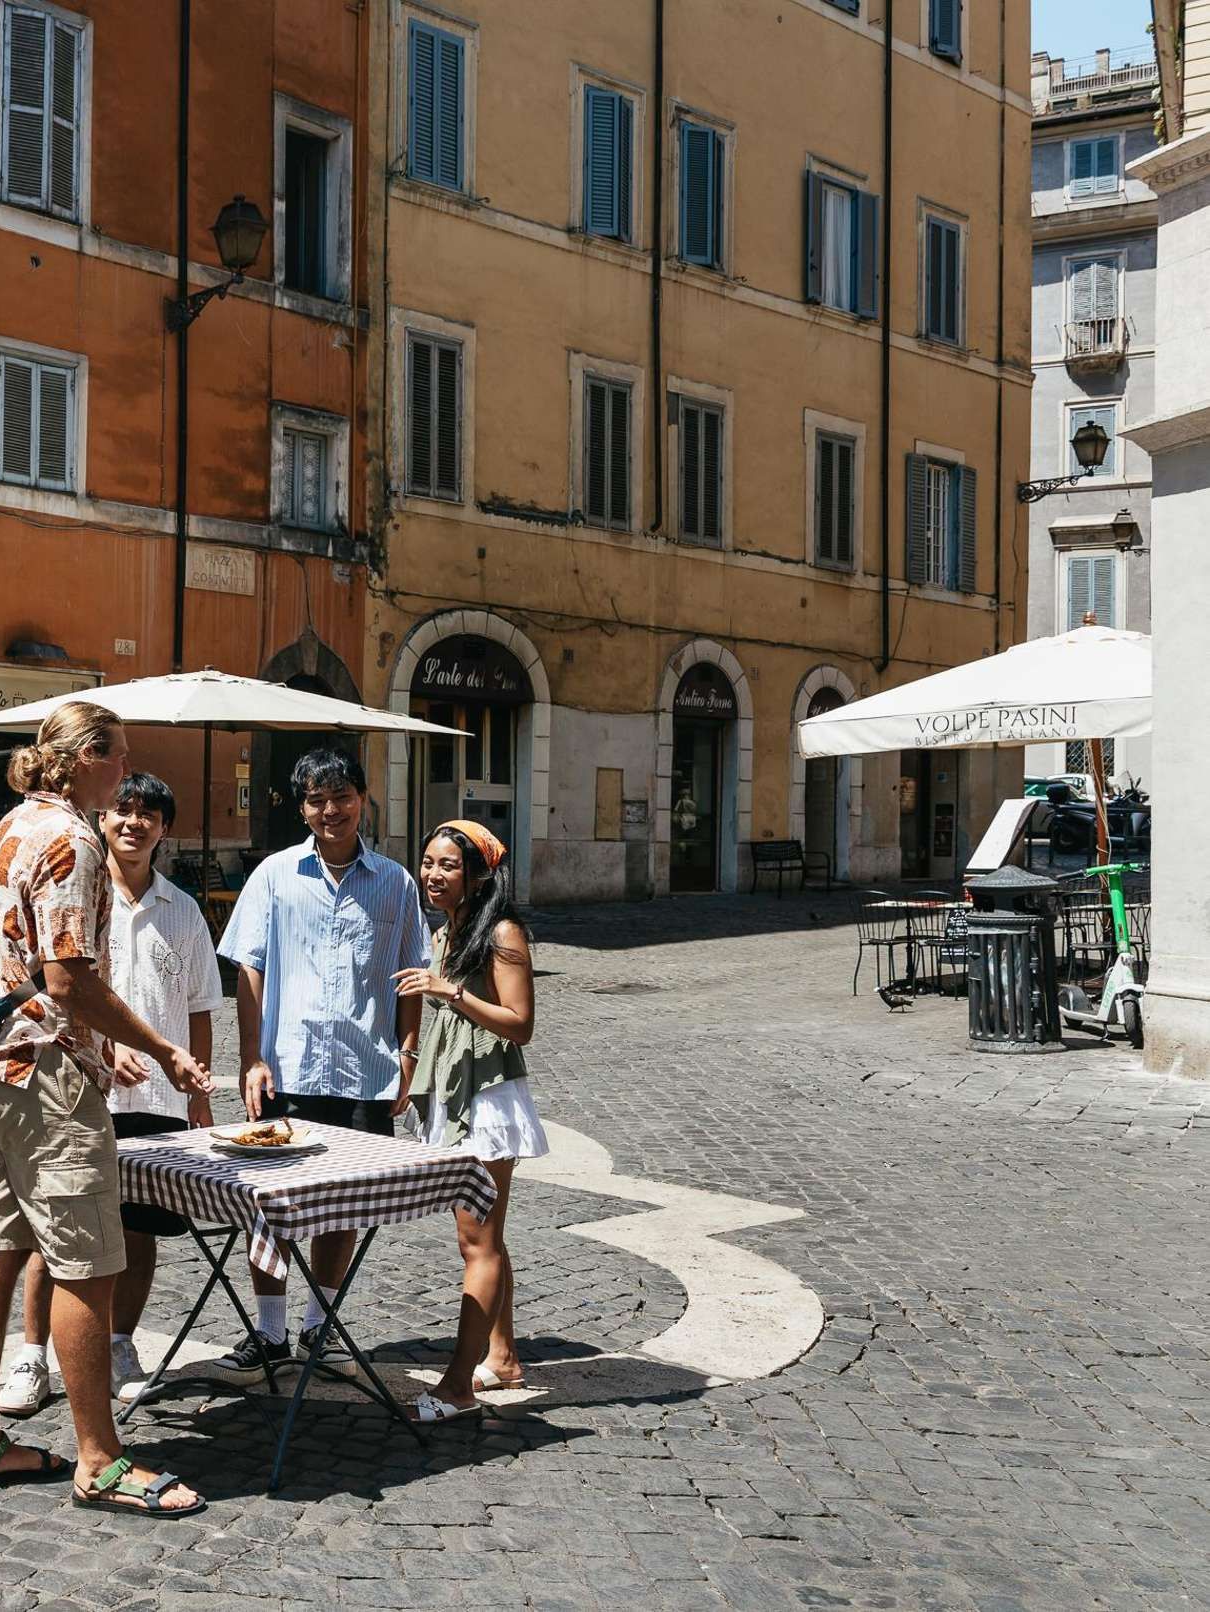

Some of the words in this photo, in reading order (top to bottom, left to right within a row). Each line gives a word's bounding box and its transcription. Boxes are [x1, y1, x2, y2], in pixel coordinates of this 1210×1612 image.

[422, 657, 462, 688] L'arte
[676, 687, 705, 709] Antico
[706, 689, 732, 712] Forno
[916, 710, 990, 733] VOLPE
[998, 706, 1076, 728] PASINI
[990, 727, 1076, 740] ITALIANO
